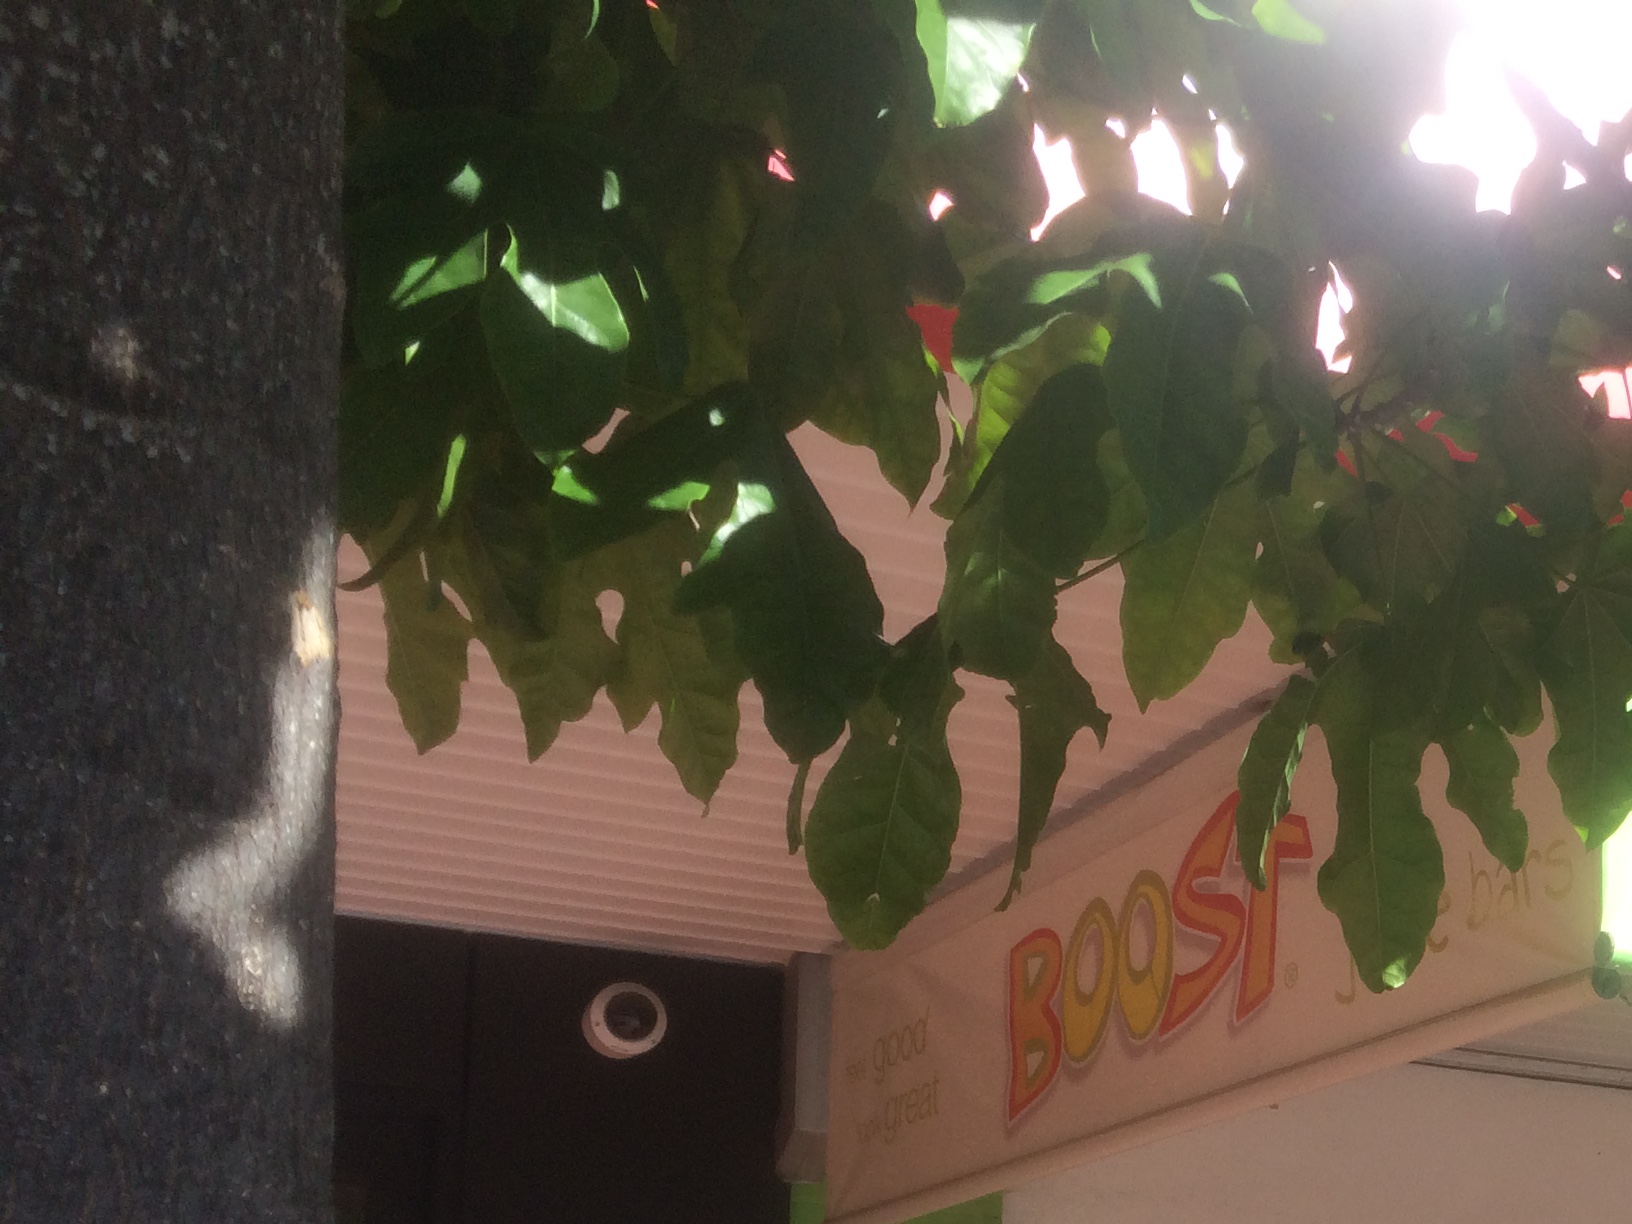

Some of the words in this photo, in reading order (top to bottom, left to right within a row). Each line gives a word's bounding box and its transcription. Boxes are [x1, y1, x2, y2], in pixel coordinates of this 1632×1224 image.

[1005, 788, 1315, 1124] BOOST
[873, 1004, 931, 1085] good
[884, 1069, 940, 1146] great
